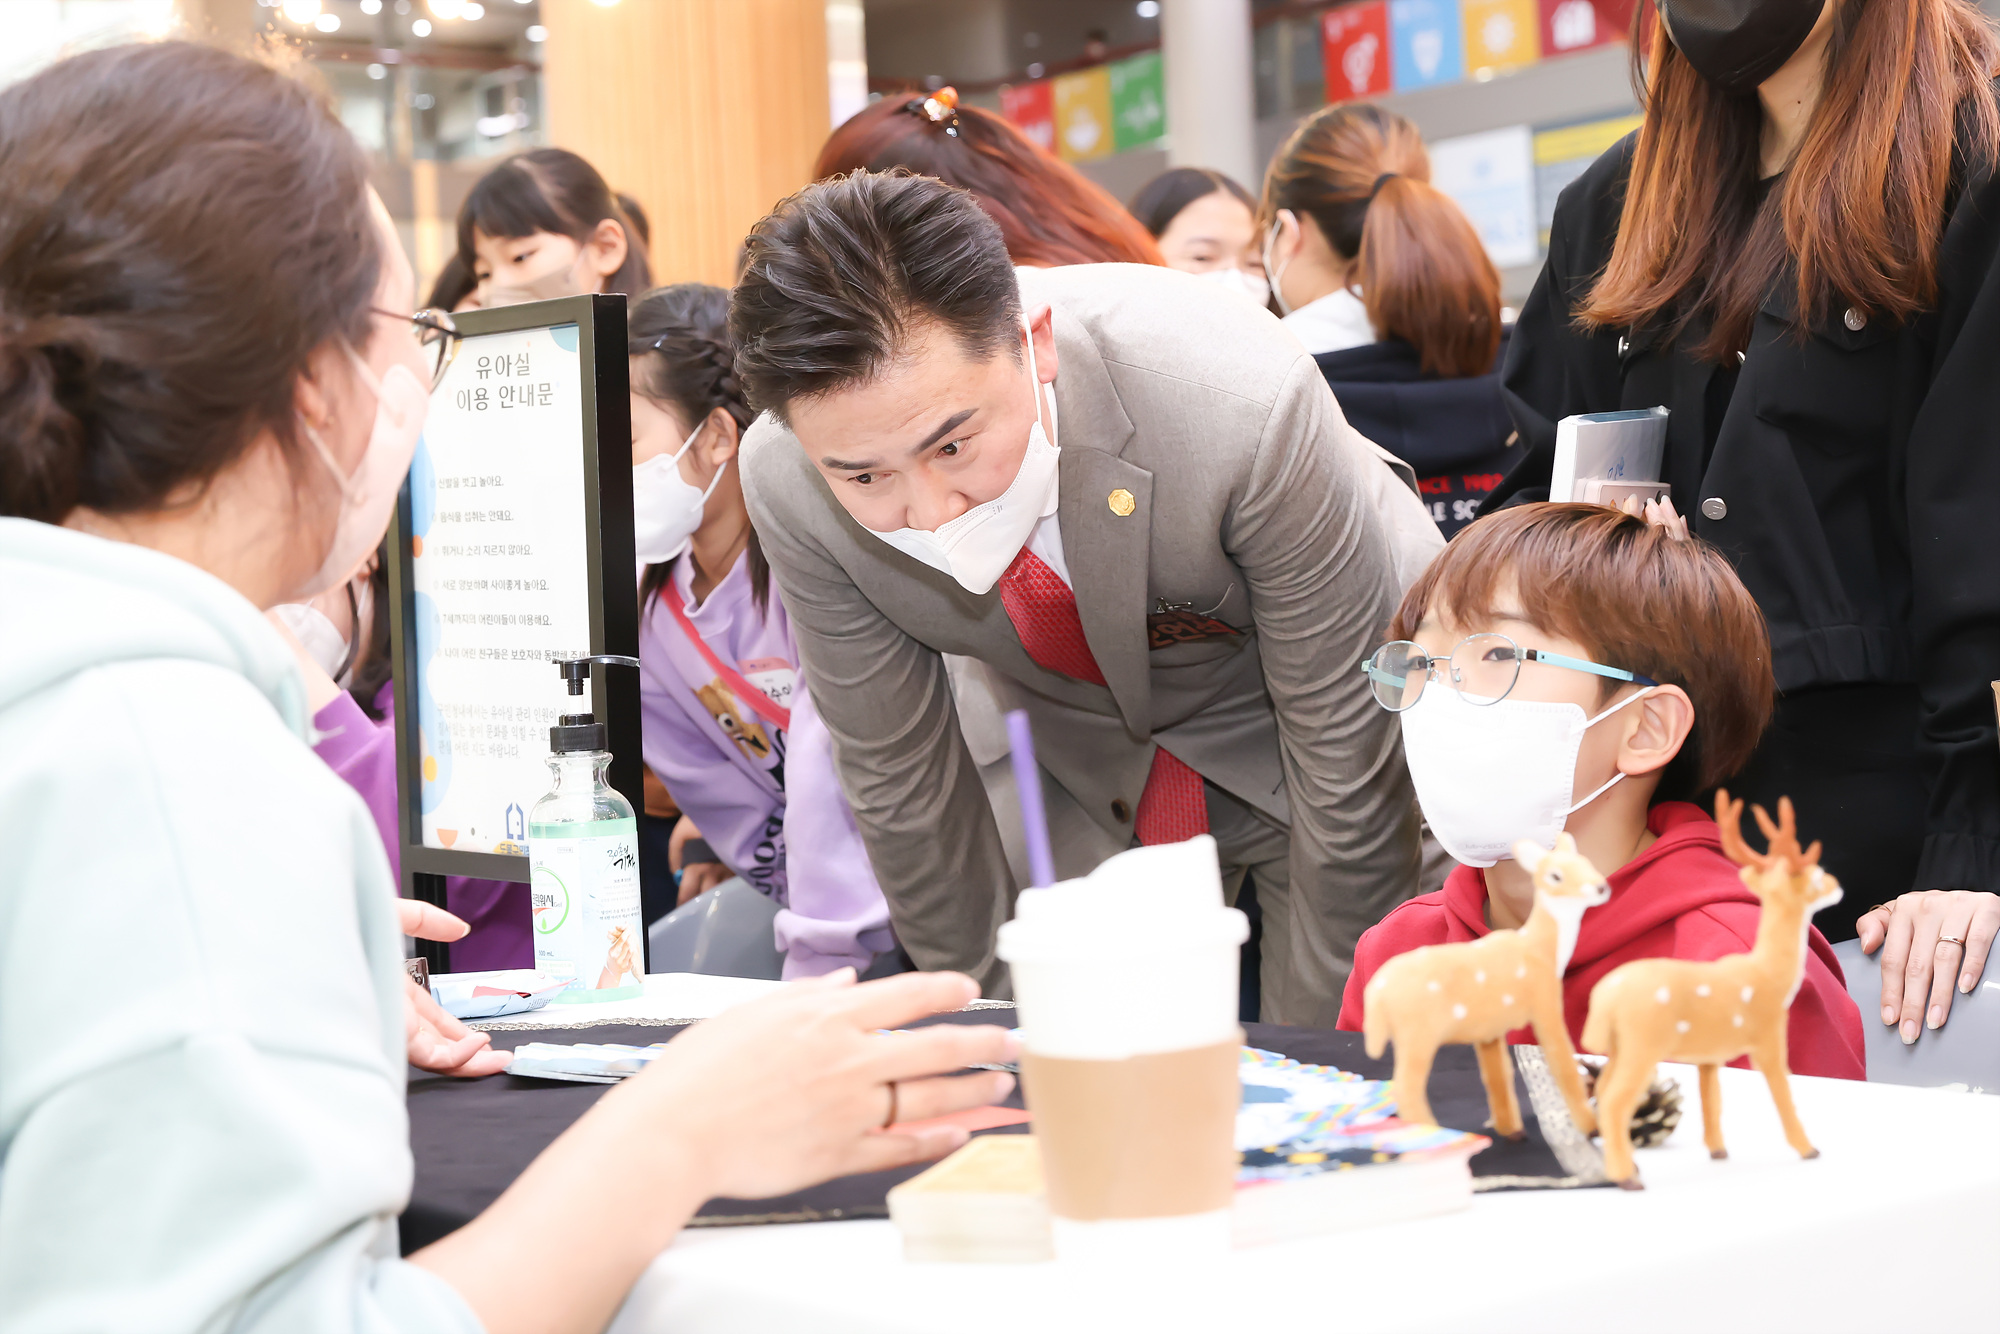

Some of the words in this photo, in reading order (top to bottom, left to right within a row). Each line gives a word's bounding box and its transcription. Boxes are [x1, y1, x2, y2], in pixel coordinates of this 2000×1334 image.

[476, 352, 531, 380] 유아실
[456, 387, 490, 411] 이용
[499, 382, 553, 409] 안내문
[438, 477, 460, 489] 신발을
[462, 476, 477, 488] 벗고
[479, 475, 504, 488] 놀아요.
[440, 511, 462, 523] 음식물
[464, 510, 486, 522] 섭취는
[488, 509, 514, 522] 안돼요.
[466, 545, 481, 556] 소리
[483, 544, 506, 556] 지르지
[508, 544, 533, 556] 않아요.
[442, 580, 456, 591] 서로
[458, 579, 489, 591] 양보하며
[490, 579, 522, 591] 사이좋게
[523, 579, 550, 591] 놀아요.
[442, 613, 477, 625] 7세까지의
[478, 614, 517, 626] 어린이들이
[518, 614, 553, 626] 이용해요.
[461, 648, 476, 660] 어린
[478, 648, 509, 660] 친구들은
[510, 649, 542, 661] 보호자와
[491, 705, 513, 722] 유아실
[534, 706, 557, 723] 인원이
[528, 726, 537, 741] 수
[488, 743, 521, 759] 바랍니다.
